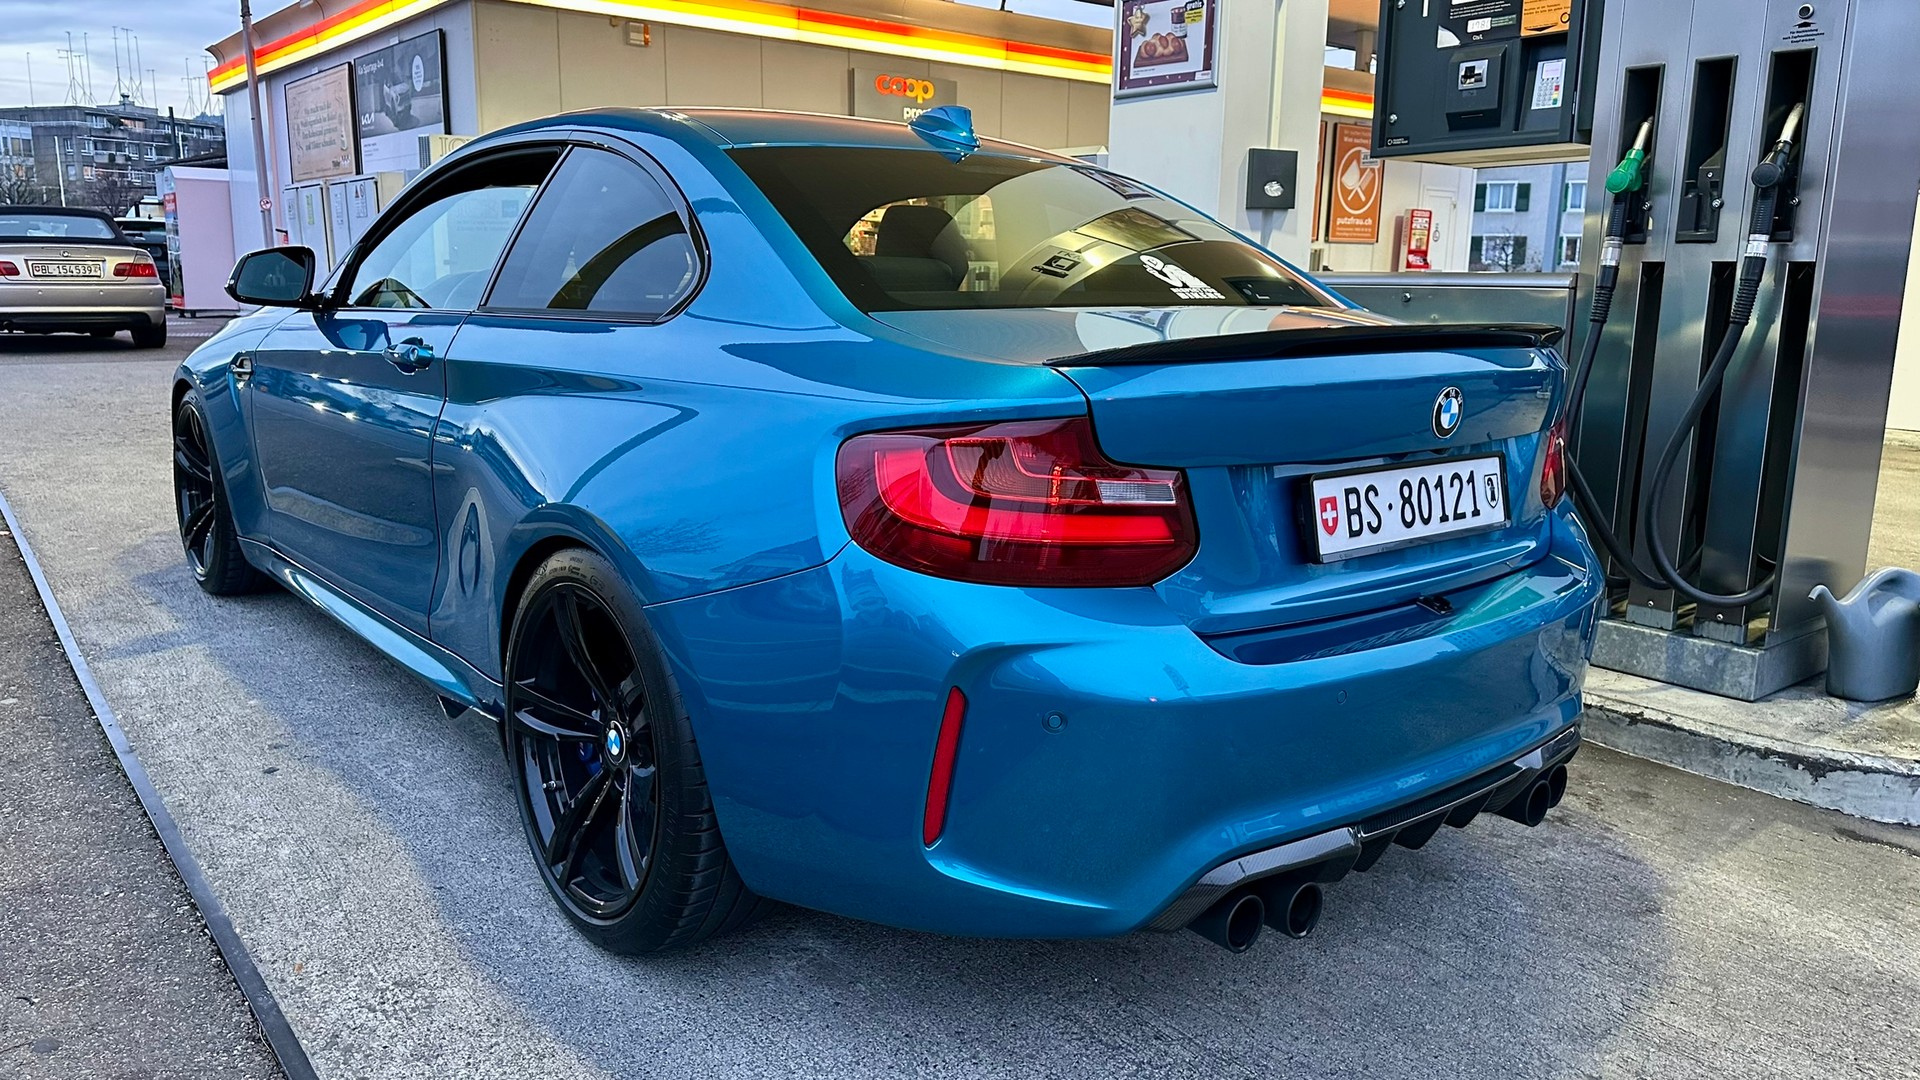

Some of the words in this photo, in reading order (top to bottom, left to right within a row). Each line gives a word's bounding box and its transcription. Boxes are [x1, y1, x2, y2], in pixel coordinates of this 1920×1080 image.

[875, 74, 935, 104] coop
[1336, 217, 1373, 226] putzfrau.ch
[1439, 388, 1463, 406] BMW
